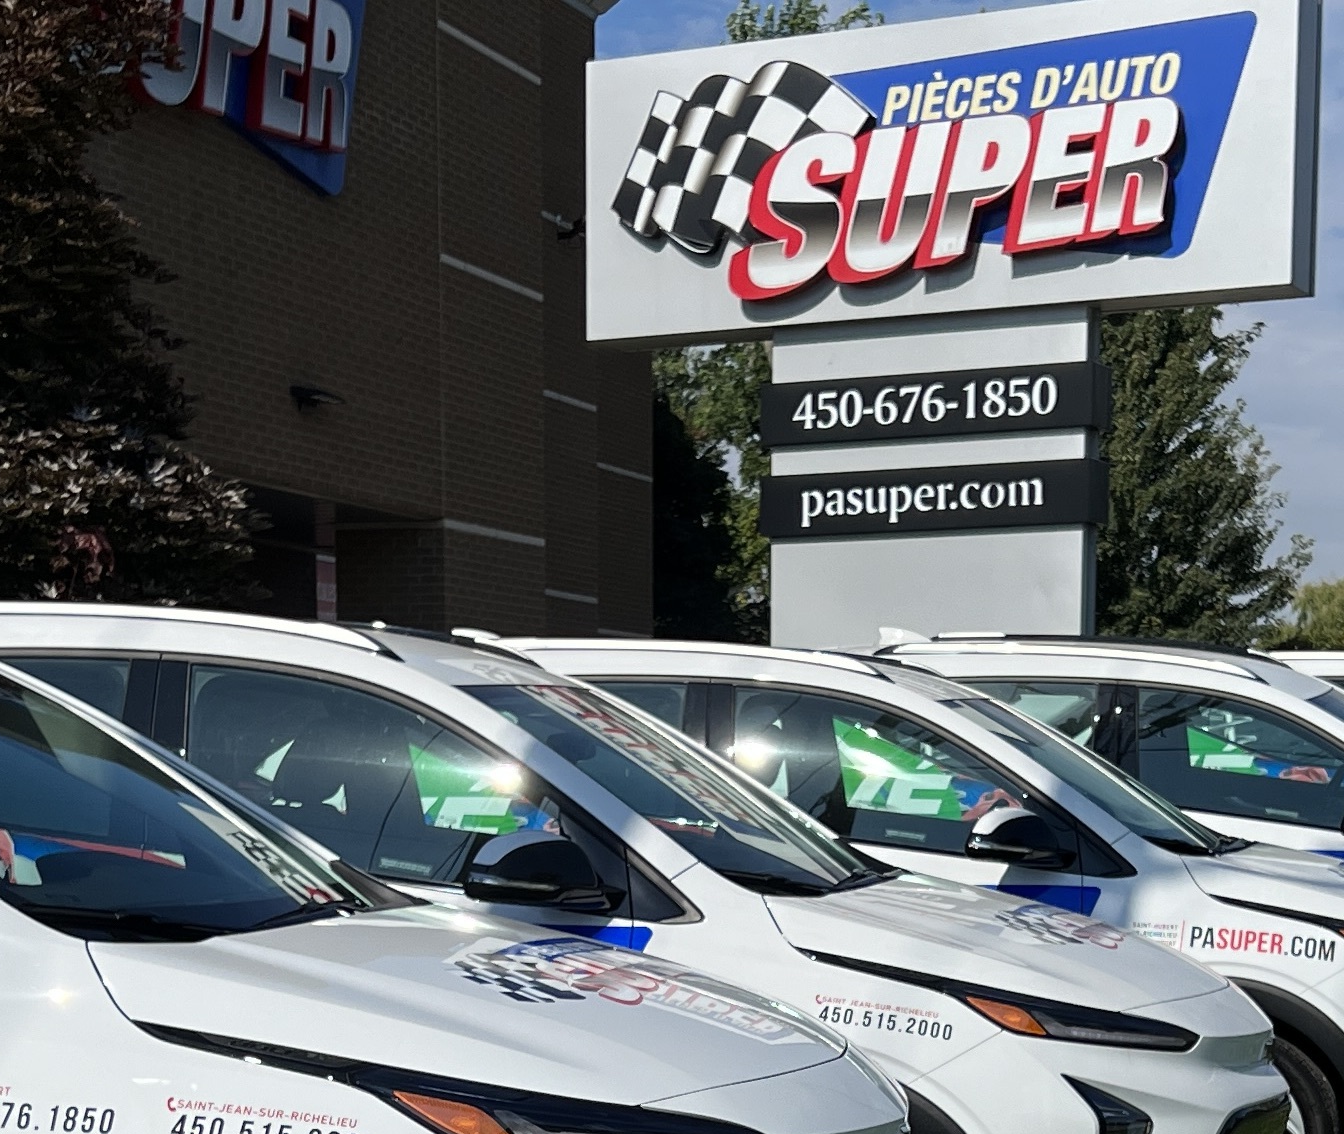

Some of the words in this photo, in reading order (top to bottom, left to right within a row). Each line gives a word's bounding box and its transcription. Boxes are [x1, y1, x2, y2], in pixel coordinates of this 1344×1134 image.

[881, 69, 1019, 126] PIÈCES
[1031, 51, 1182, 112] D'AUTO
[730, 97, 1182, 300] SUPER
[792, 374, 1058, 431] 450-676-1850
[800, 477, 1044, 527] pasuper.com
[1189, 926, 1336, 962] PASUPER.COM
[818, 1005, 953, 1041] 450.515.2000
[176, 1099, 359, 1129] SAINT-JEAN-SUR-RICHELIEU
